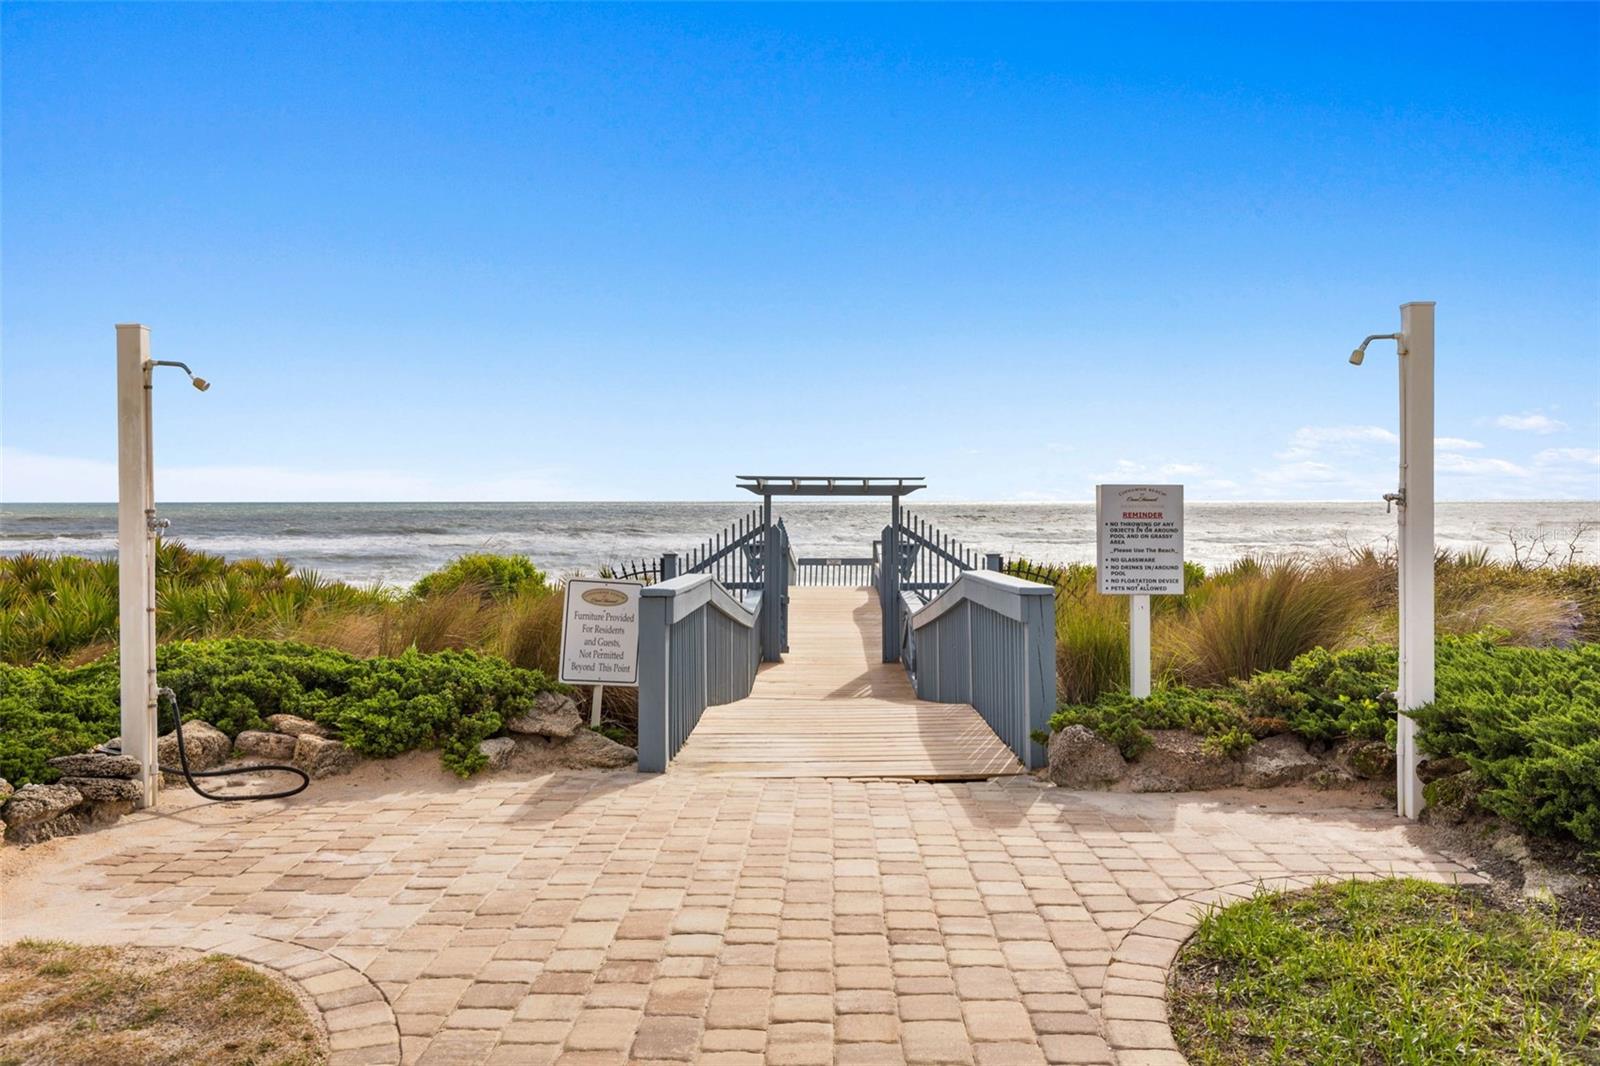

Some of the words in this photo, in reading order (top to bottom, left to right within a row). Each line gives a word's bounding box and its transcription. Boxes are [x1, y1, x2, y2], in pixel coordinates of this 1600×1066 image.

[1122, 511, 1164, 520] REMINDER
[574, 610, 604, 621] Furniture
[605, 612, 635, 623] Provided
[582, 624, 593, 633] For
[594, 624, 625, 635] Residents
[584, 637, 596, 646] and
[579, 649, 592, 658] Not
[593, 649, 624, 660] Permitted
[571, 661, 595, 673] Beyond
[599, 662, 612, 672] This
[613, 663, 631, 673] Point
